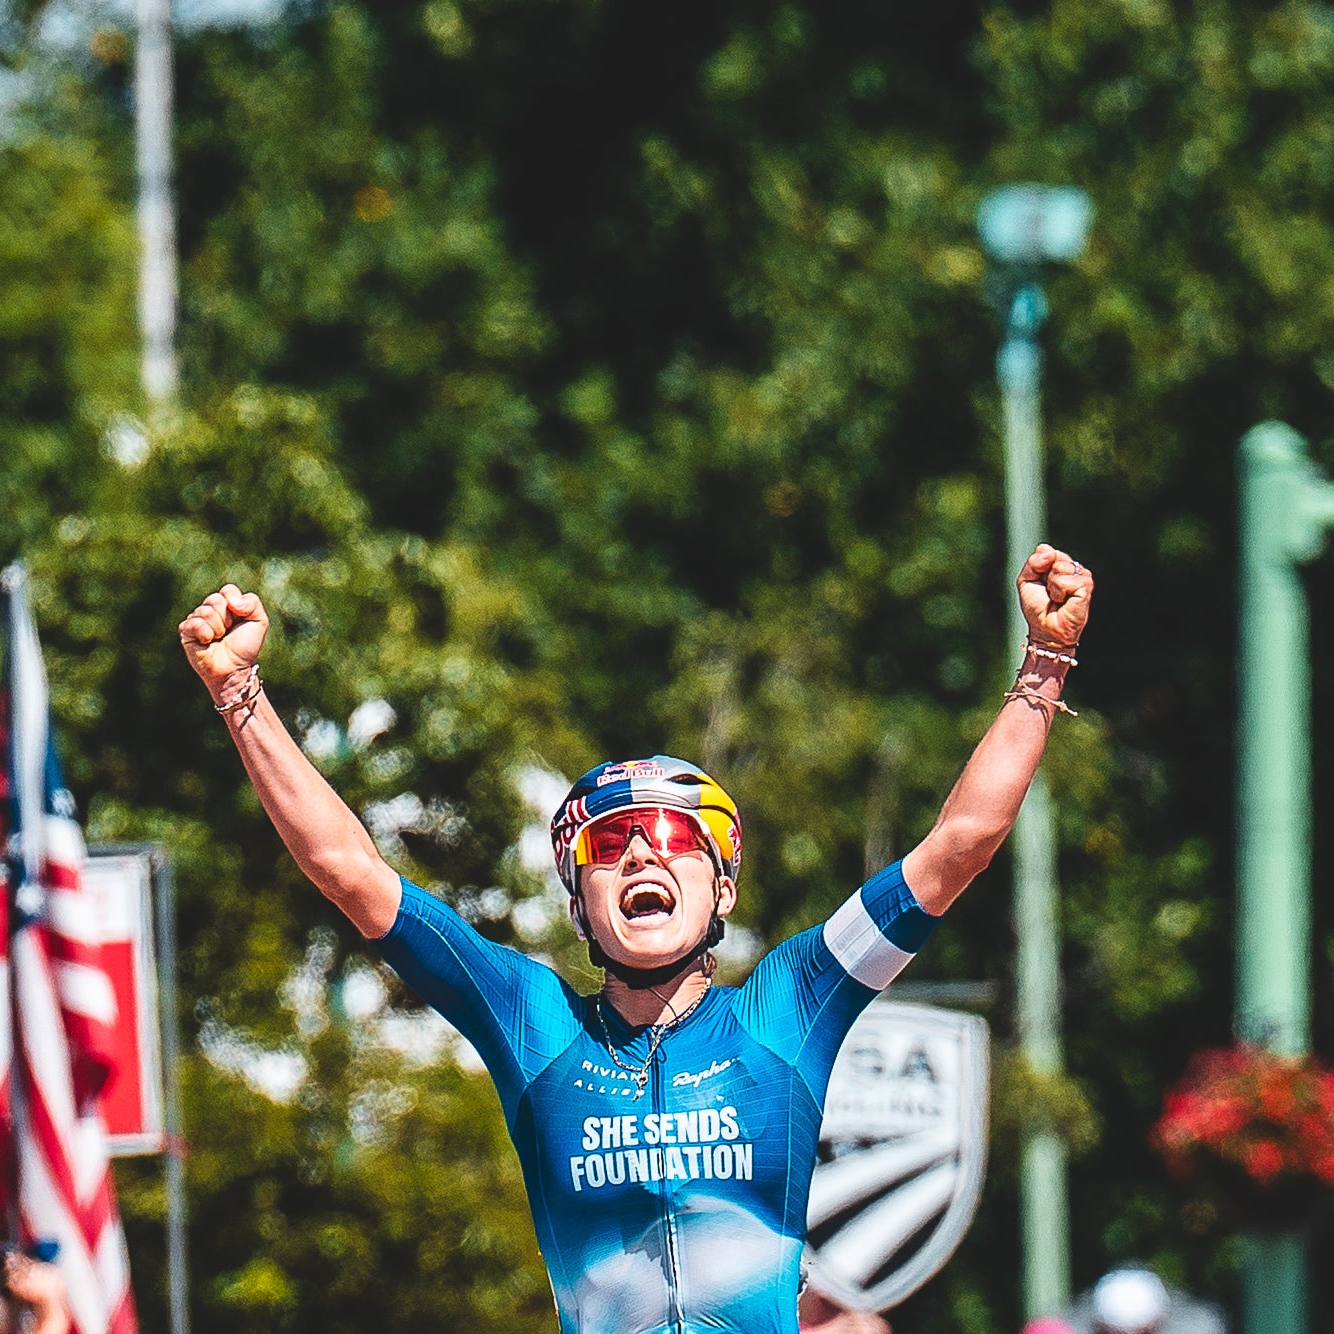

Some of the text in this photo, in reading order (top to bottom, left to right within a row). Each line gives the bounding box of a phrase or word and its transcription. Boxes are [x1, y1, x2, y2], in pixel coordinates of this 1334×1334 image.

[582, 1060, 644, 1082] RIVIAN
[582, 1106, 740, 1151] SHE SENDS
[570, 1143, 753, 1192] FOUNDATION
